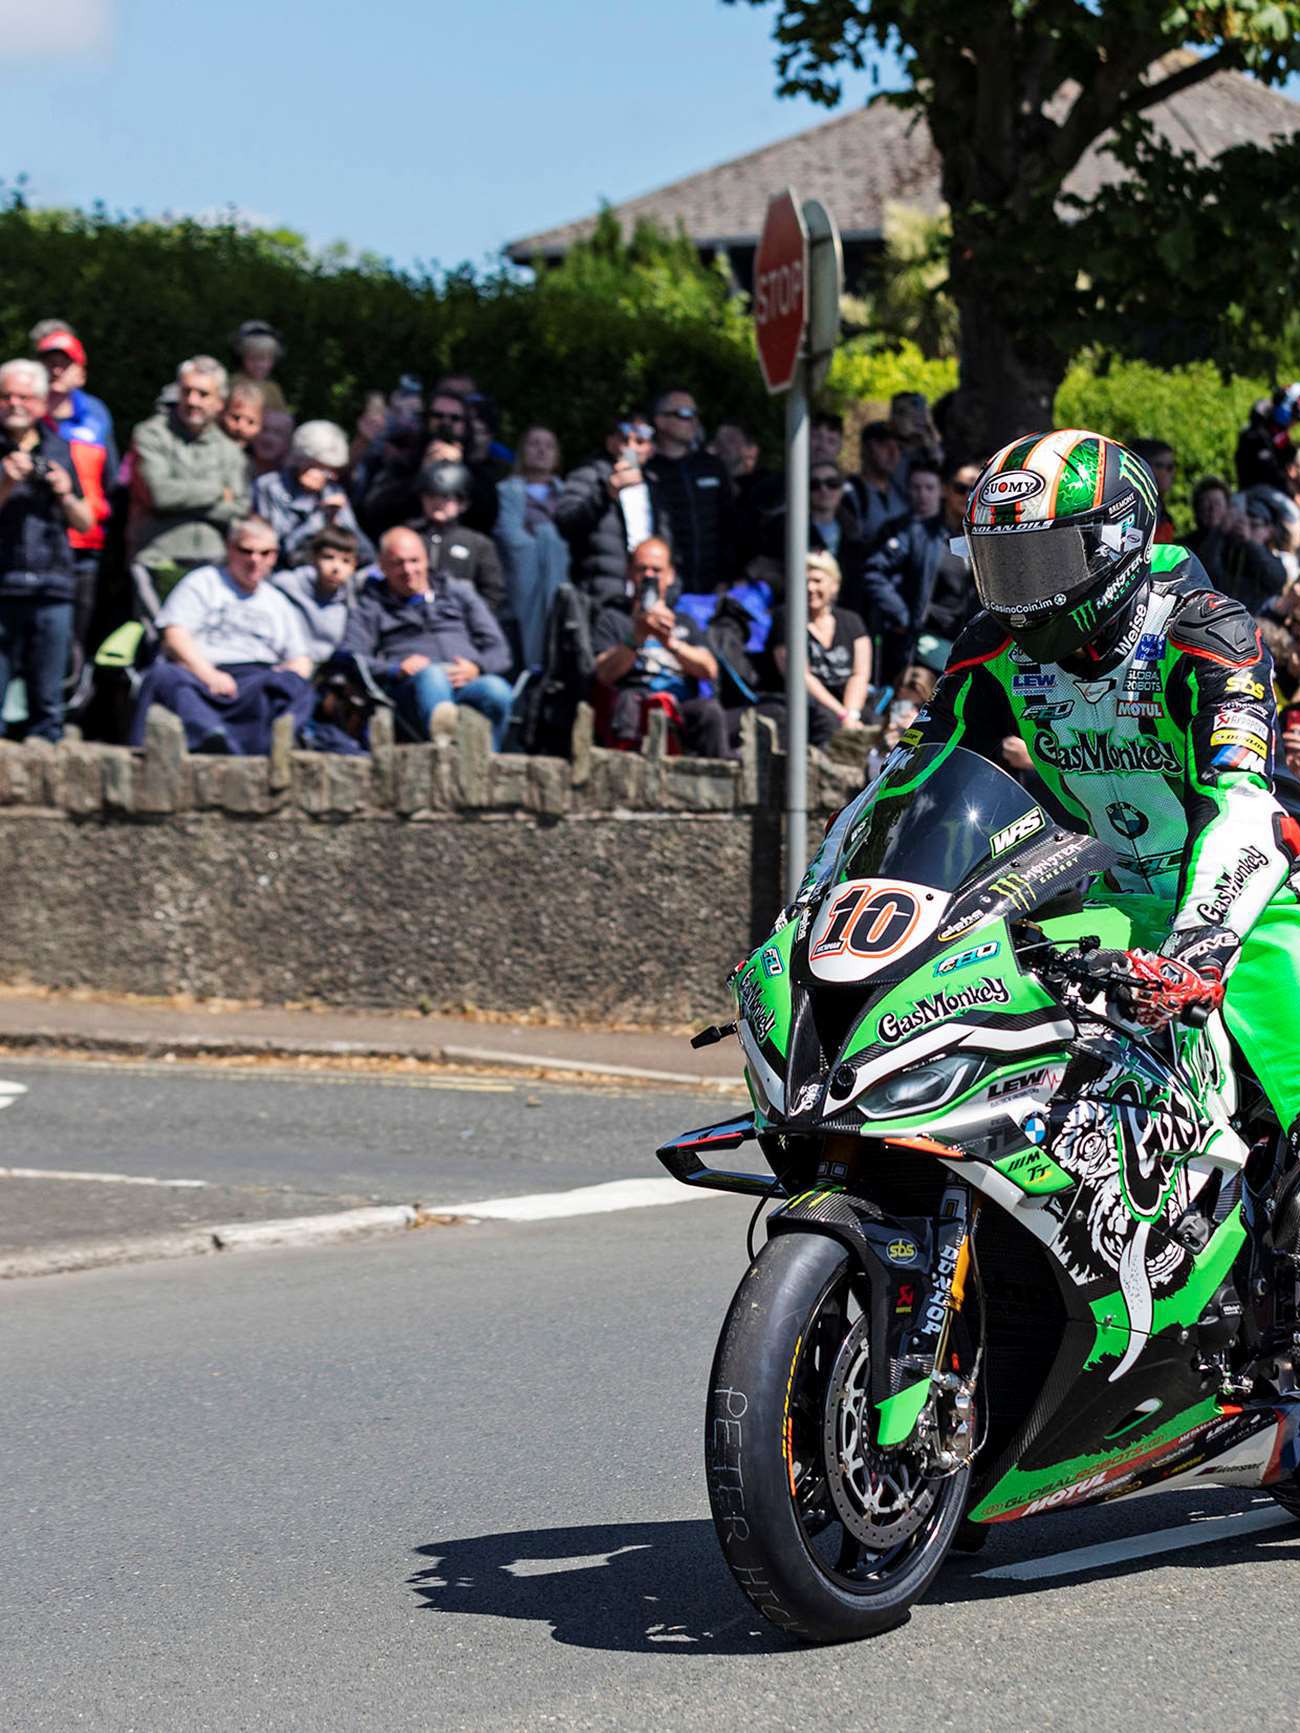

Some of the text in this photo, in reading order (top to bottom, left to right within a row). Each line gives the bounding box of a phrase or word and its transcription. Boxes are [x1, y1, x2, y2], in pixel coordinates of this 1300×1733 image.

[757, 259, 801, 323] STOP
[984, 480, 1035, 497] SUOMY
[972, 523, 1015, 534] NOLAN
[1114, 603, 1148, 656] Weise
[1013, 674, 1056, 688] LEW
[1117, 702, 1163, 717] MOTUL
[993, 809, 1041, 855] WRS
[811, 885, 922, 960] 10
[988, 1068, 1045, 1098] LEW
[713, 1386, 751, 1544] PETER
[1020, 1471, 1108, 1518] MOTUL
